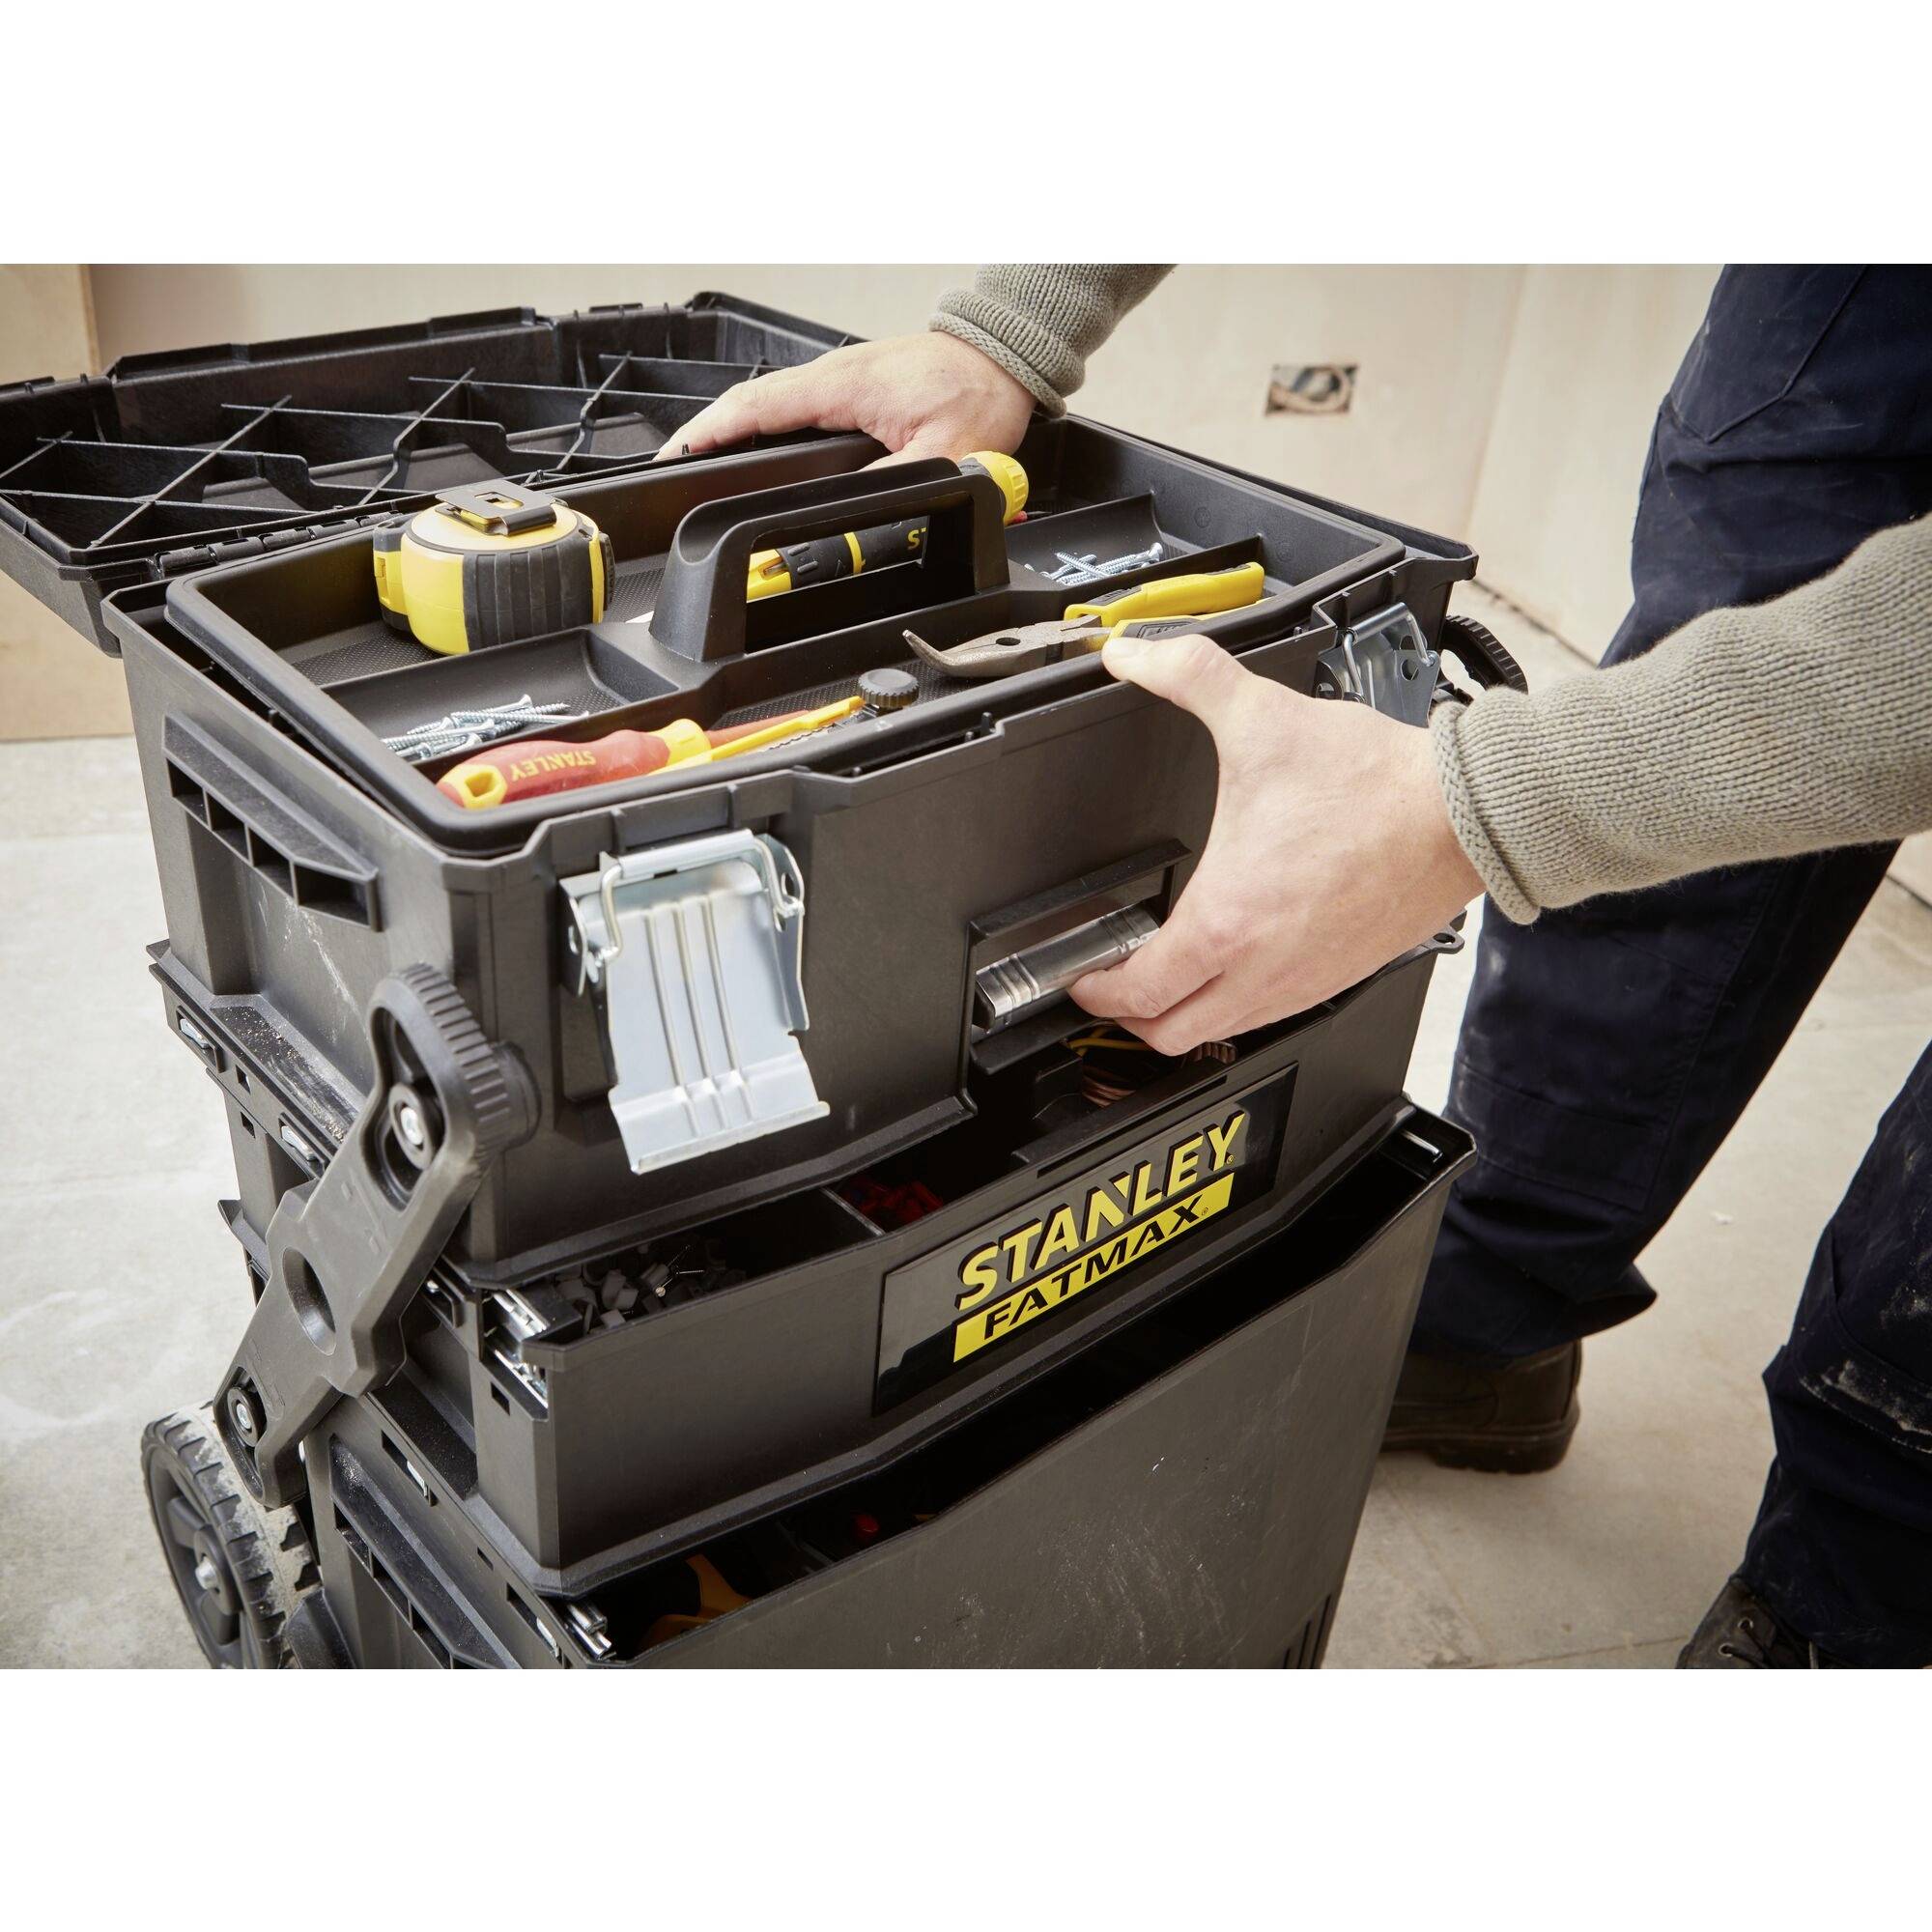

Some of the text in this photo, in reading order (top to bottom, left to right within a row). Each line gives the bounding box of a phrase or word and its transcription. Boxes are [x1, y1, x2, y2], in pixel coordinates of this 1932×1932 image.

[510, 751, 597, 782] STANLEY
[954, 1110, 1245, 1311] STANLEY
[983, 1195, 1202, 1341] FATMAX
